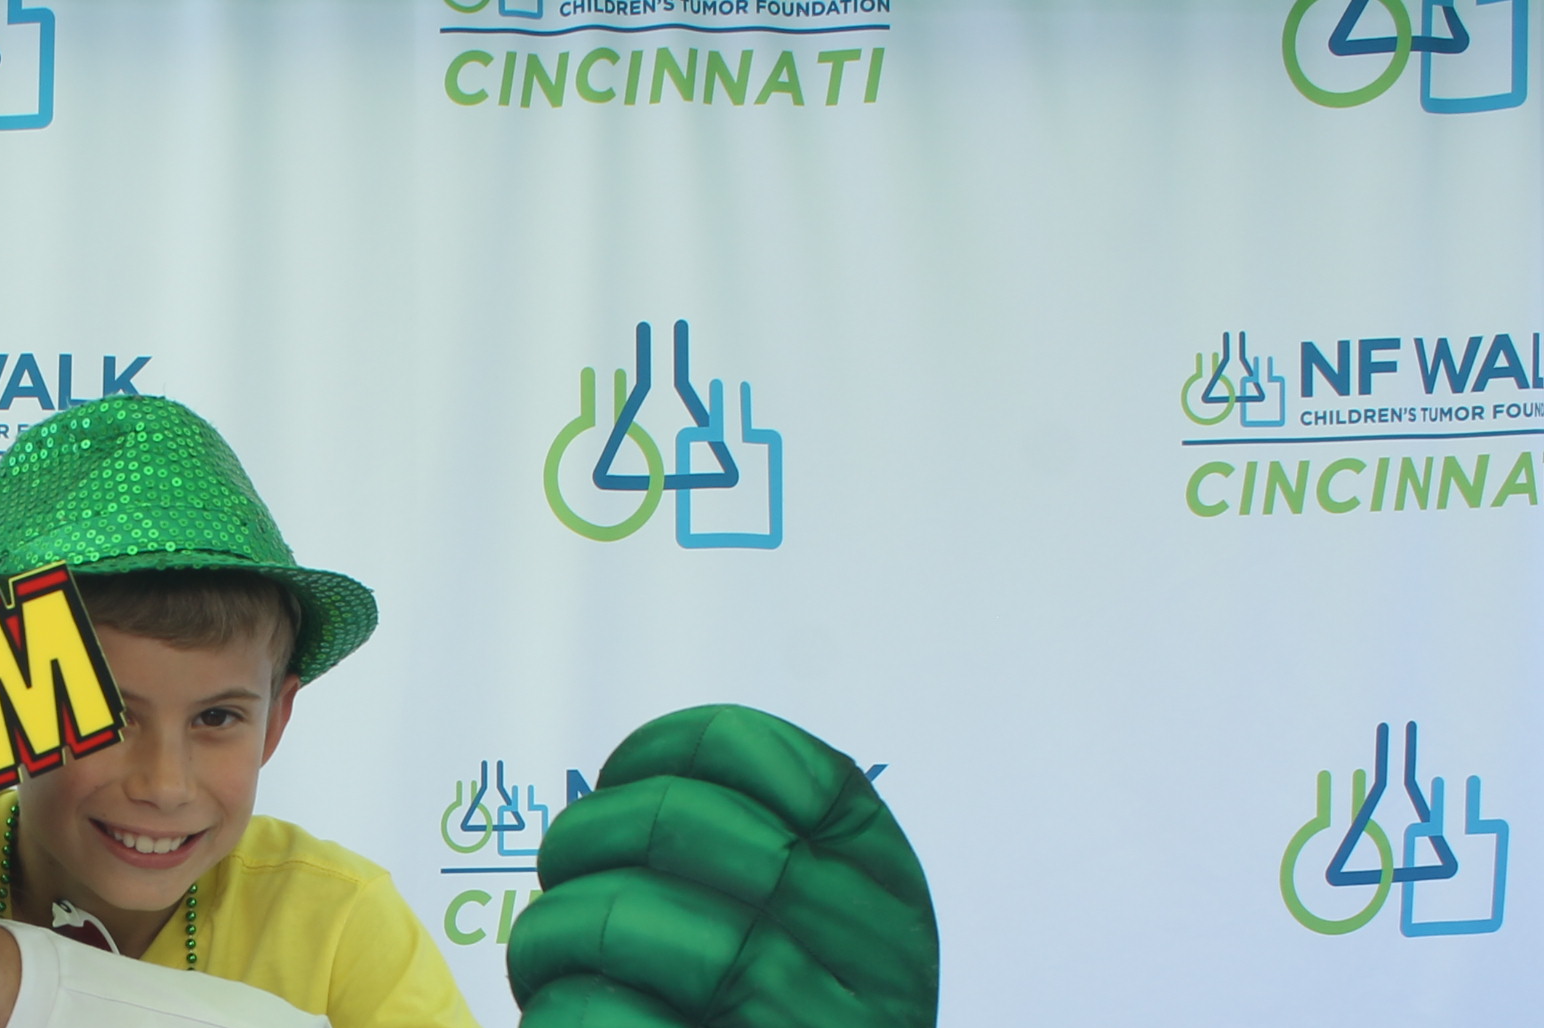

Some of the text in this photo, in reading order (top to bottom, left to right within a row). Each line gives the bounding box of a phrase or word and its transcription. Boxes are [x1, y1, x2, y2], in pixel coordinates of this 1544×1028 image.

[681, 0, 748, 15] TUMOR
[756, 0, 890, 17] FOUNDATION
[444, 47, 885, 108] CINCINNATI
[1300, 337, 1401, 398] NF
[1300, 406, 1416, 426] CHILDREN'S
[1420, 405, 1485, 422] TUMOR
[1185, 451, 1544, 518] CINCINNA
